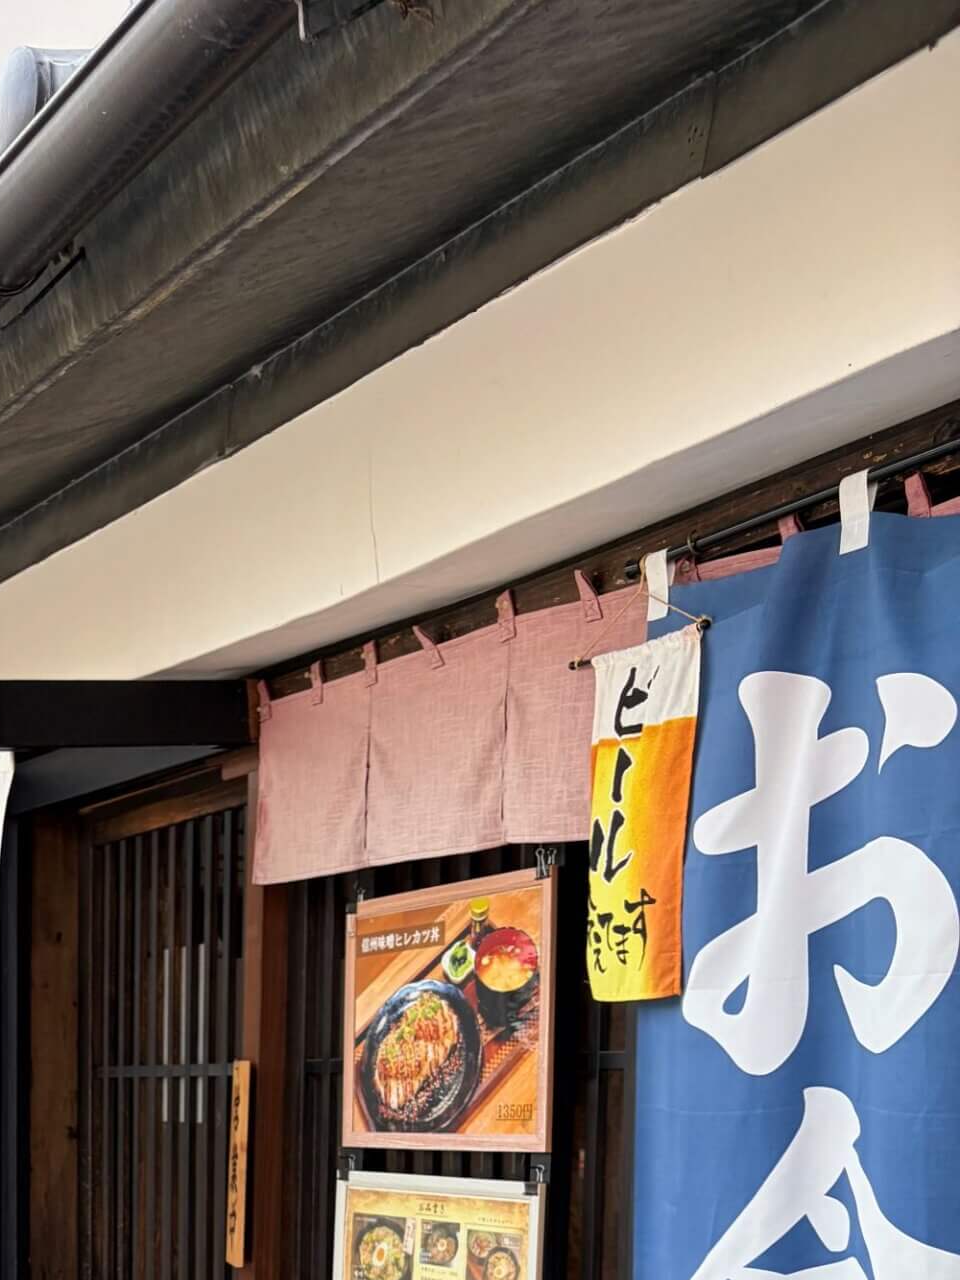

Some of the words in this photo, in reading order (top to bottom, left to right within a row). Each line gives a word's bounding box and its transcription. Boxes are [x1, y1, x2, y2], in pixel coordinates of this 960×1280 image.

[589, 665, 659, 884] ビール
[361, 926, 441, 953] 信州味噌ヒレカツ丼
[497, 1103, 533, 1119] 1350円
